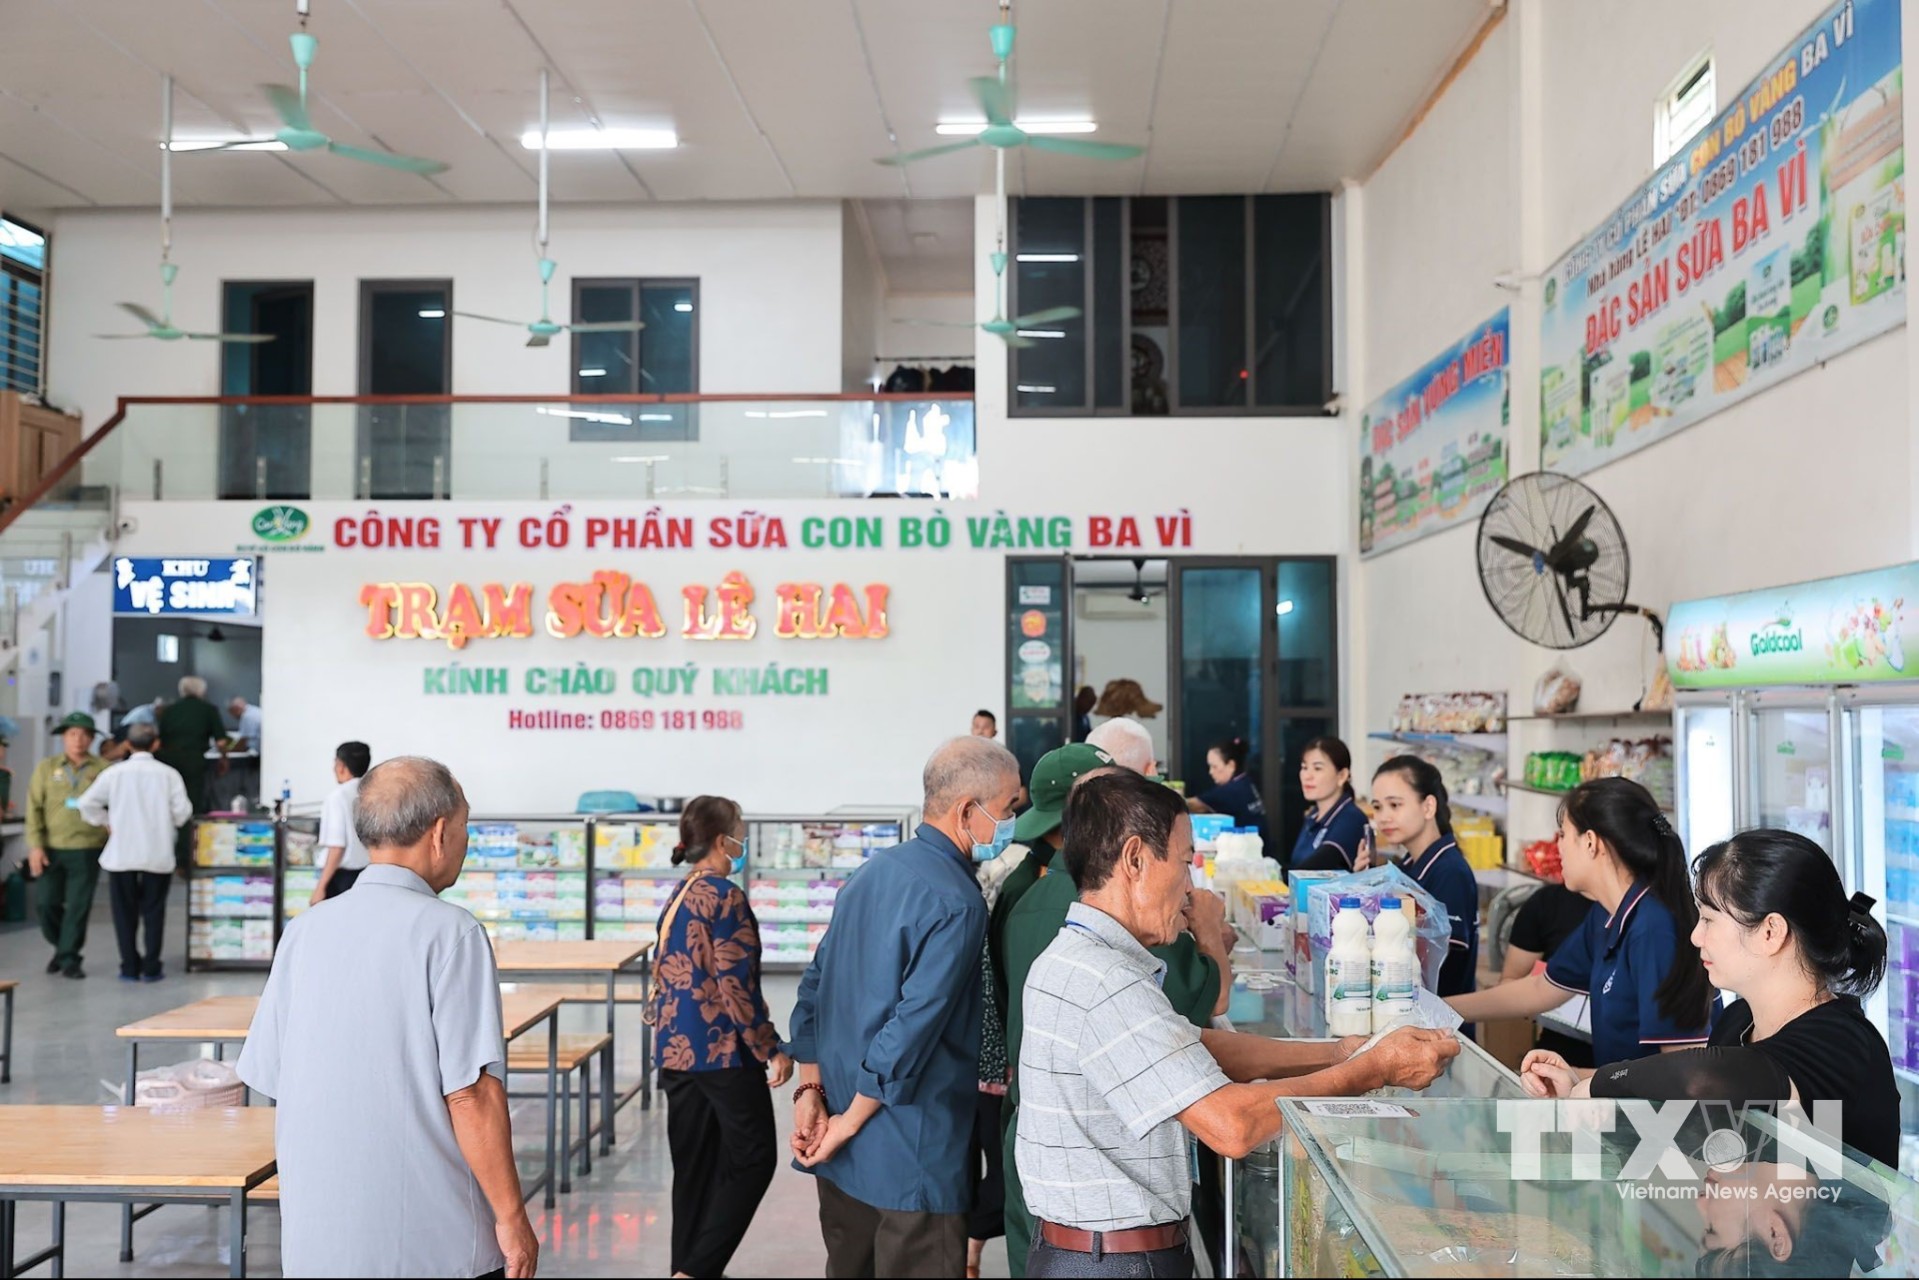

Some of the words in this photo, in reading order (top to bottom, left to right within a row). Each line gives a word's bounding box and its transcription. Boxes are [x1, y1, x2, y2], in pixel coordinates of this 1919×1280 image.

[1723, 101, 1746, 148] BÒ
[1750, 58, 1797, 123] VÀNG
[1801, 31, 1829, 78] BA
[1832, 1, 1854, 47] VÌ
[1702, 157, 1736, 204] 0869
[1740, 131, 1766, 175] 181
[1771, 99, 1803, 147] 988
[1586, 294, 1621, 357] ĐẶC
[1627, 256, 1670, 327] SẢN
[1676, 218, 1724, 293] SỮA
[1732, 183, 1770, 253] BA
[1778, 138, 1807, 219] VÌ
[1462, 327, 1505, 385] MIỀN
[334, 510, 440, 549] CÔNG
[458, 517, 504, 549] TY
[519, 504, 572, 549] CỔ
[586, 506, 693, 549] PHẦN
[709, 511, 787, 549] SỮA
[801, 516, 883, 549] CON
[899, 509, 951, 549] BÒ
[967, 509, 1072, 549] VÀNG
[1089, 516, 1141, 548] BA
[1155, 508, 1192, 548] VÌ
[161, 559, 210, 577] KHU
[130, 576, 164, 614] VỆ
[358, 581, 535, 650] TRẠM
[544, 569, 667, 639] SỮA
[680, 569, 759, 641] LÊ
[773, 582, 890, 640] HAI
[1751, 629, 1803, 656] Goldcool
[423, 661, 508, 695] KÍNH
[525, 661, 616, 696] CHÀO
[632, 662, 700, 697] QUÝ
[713, 662, 829, 696] KHÁCH
[508, 709, 594, 731] Hotline:
[600, 710, 654, 731] 0869
[661, 710, 697, 731] 181
[702, 710, 744, 731] 988
